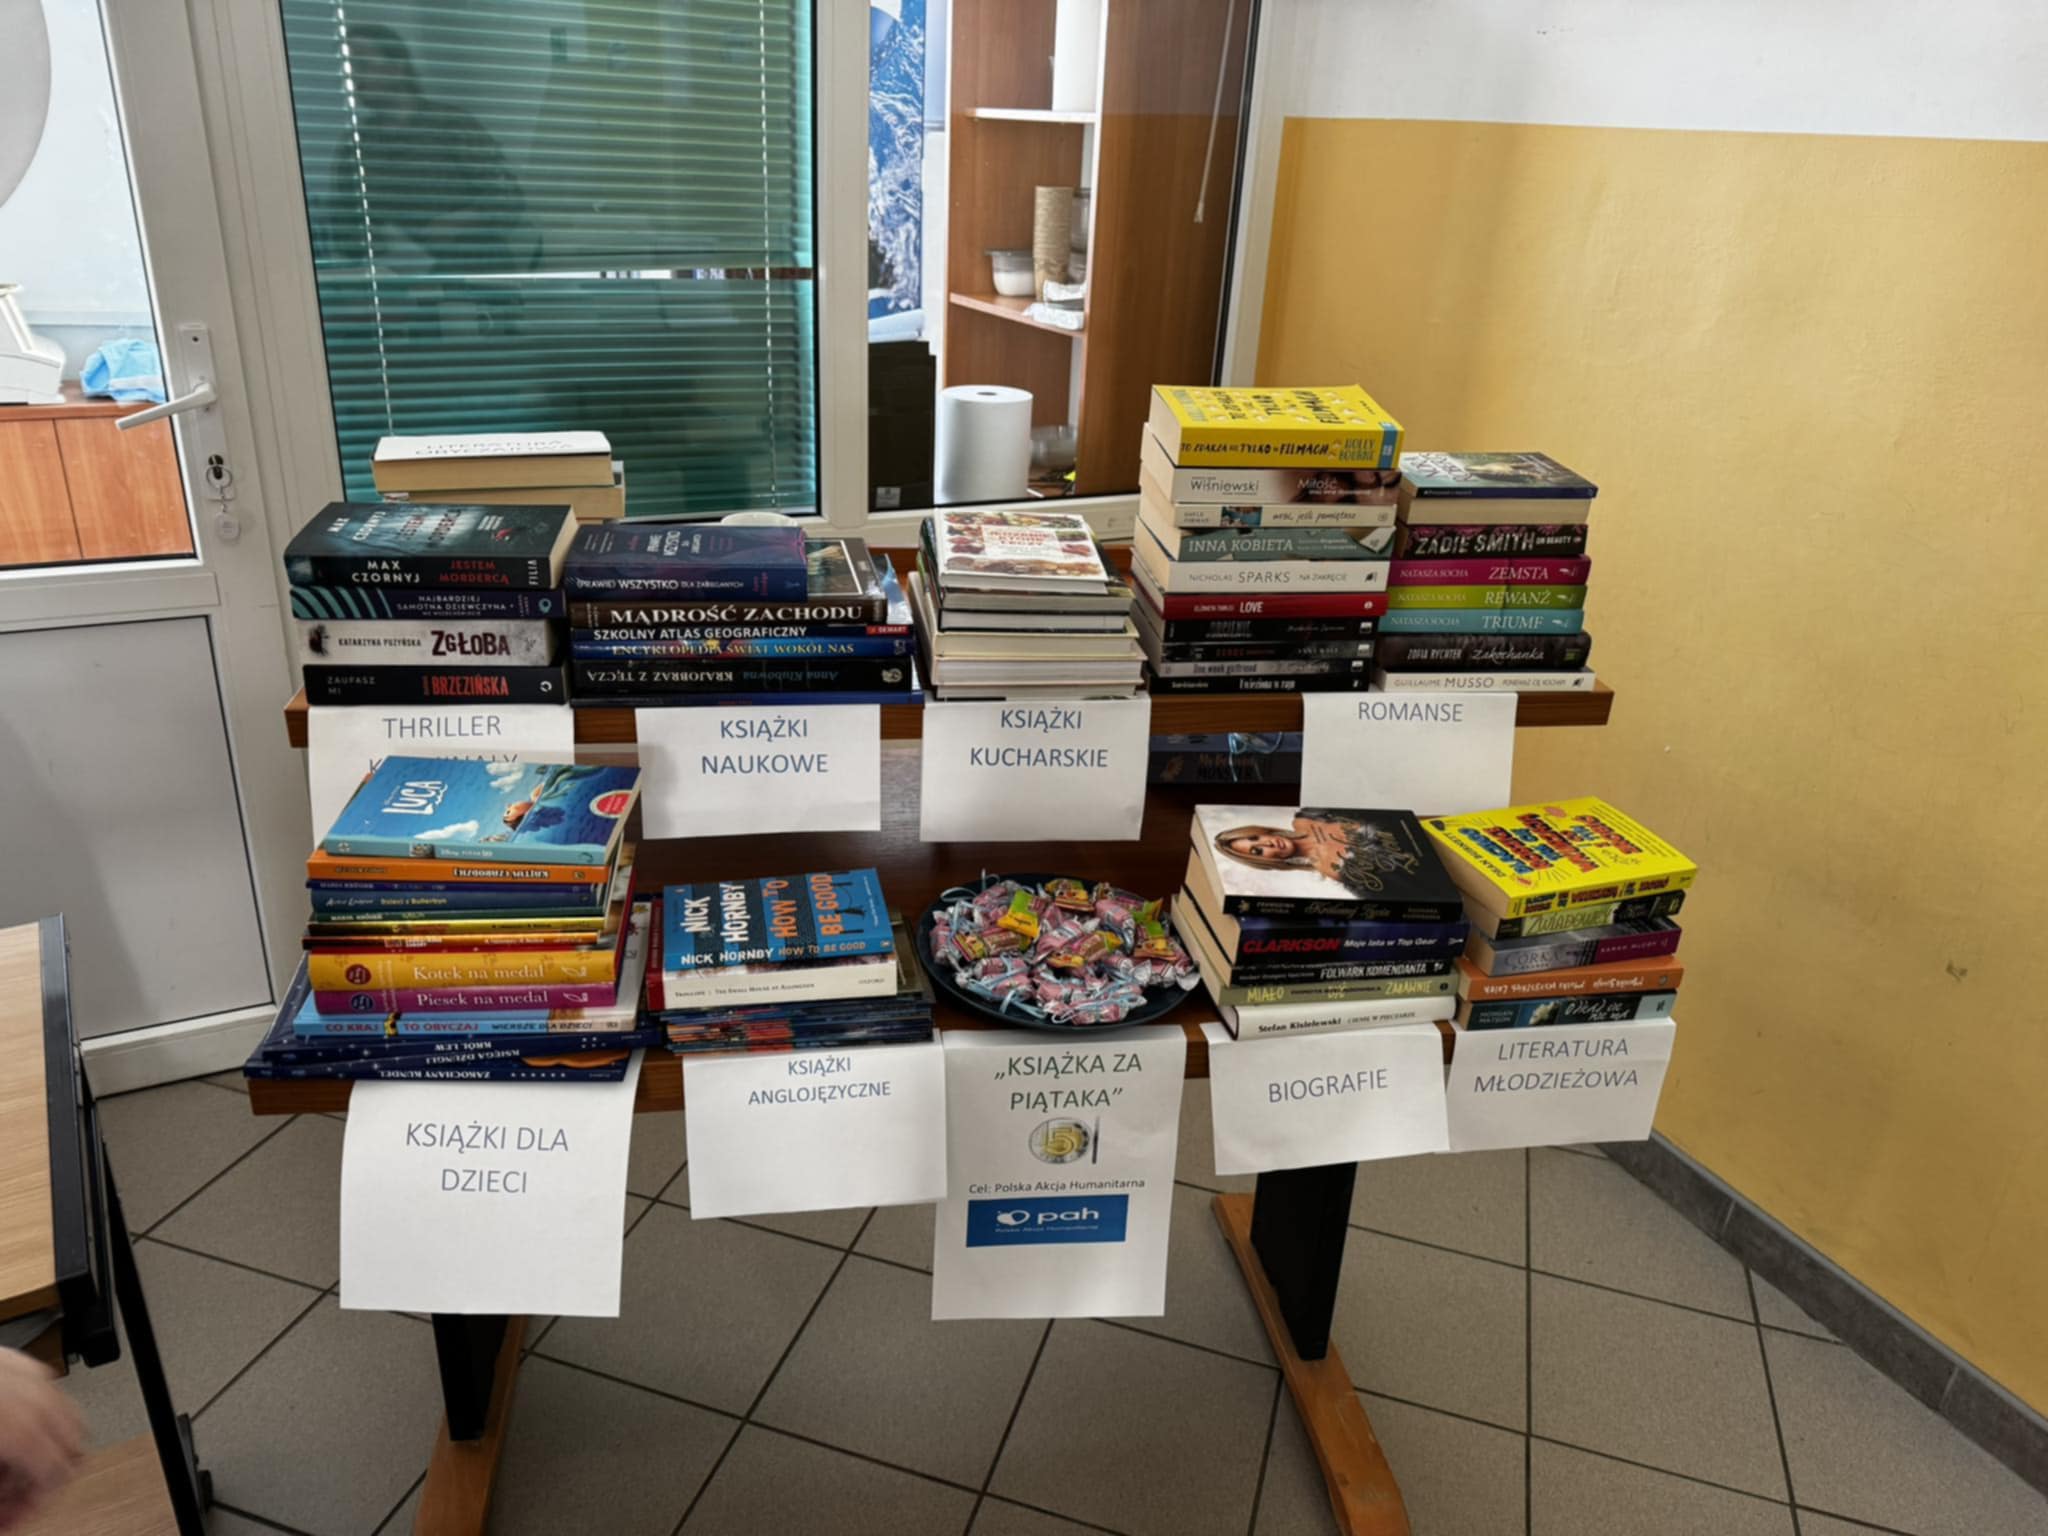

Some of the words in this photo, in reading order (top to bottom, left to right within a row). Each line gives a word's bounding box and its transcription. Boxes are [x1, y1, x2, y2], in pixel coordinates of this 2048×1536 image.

[1190, 478, 1259, 492] Wiśniewski
[1297, 477, 1337, 490] Miłość
[1188, 539, 1227, 553] INNA
[1232, 538, 1294, 552] KOBIETA
[1415, 536, 1469, 555] ZADIE
[1474, 532, 1536, 553] SMITH
[367, 560, 401, 570] MAX
[450, 560, 496, 570] JESTEM
[1488, 566, 1549, 581] ZEMSTA
[351, 572, 421, 584] CZORNYJ
[439, 572, 509, 585] MORDERCĄ
[617, 578, 680, 590] WSZYSTKO
[1238, 571, 1291, 584] SPARKS
[1485, 589, 1552, 605] REWANŻ
[610, 604, 737, 626] MĄDROŚĆ
[744, 606, 862, 622] ZACHODU
[1239, 601, 1264, 614] LOVE
[1482, 615, 1545, 630] TRIUMF
[593, 628, 656, 641] SZKOLNY
[660, 627, 701, 639] ATLAS
[704, 626, 807, 640] GEOGRAFICZNY
[430, 629, 511, 657] ZGŁOBA
[827, 643, 855, 654] NAS
[327, 676, 376, 685] ZAUFASZ
[431, 674, 510, 696] BRZEZIŃSKA
[653, 671, 734, 682] KRAJOBRAZ
[1444, 677, 1495, 689] MUSSO
[1000, 706, 1083, 733] KSIĄŻKI
[1357, 701, 1464, 722] ROMANSE
[382, 715, 501, 738] THRILLER
[720, 715, 808, 742] KSIĄŻKI
[701, 753, 829, 774] NAUKOWE
[970, 747, 1109, 768] KUCHARSKIE
[381, 779, 444, 816] LUCA
[763, 879, 790, 897] TO
[810, 873, 840, 912] GOOD
[680, 895, 711, 934] NICK
[719, 882, 750, 943] HORNBY
[769, 898, 798, 938] HOW
[818, 912, 843, 937] BE
[681, 952, 714, 966] NICK
[719, 947, 775, 963] HORNBY
[778, 945, 804, 957] HOW
[807, 944, 820, 955] TO
[823, 943, 837, 953] BE
[839, 941, 866, 952] GOOD
[1242, 937, 1341, 955] CLARKSON
[1397, 938, 1414, 949] Top
[1415, 936, 1438, 946] Gear
[413, 966, 463, 981] Kotek
[468, 970, 488, 980] na
[494, 963, 545, 979] medal
[1320, 966, 1365, 980] FOLWARK
[1367, 961, 1427, 977] KOMENDANTA
[417, 992, 468, 1008] Piesek
[474, 995, 494, 1005] na
[501, 989, 549, 1005] medal
[1247, 986, 1285, 1002] MIAŁO
[325, 1022, 344, 1032] CO
[347, 1022, 380, 1032] KRAJ
[403, 1022, 420, 1032] TO
[423, 1022, 479, 1032] OBYCZAJ
[491, 1023, 538, 1032] WIERSZE
[1258, 1022, 1287, 1033] Stefan
[1289, 1017, 1341, 1031] Kisielewski
[434, 1042, 459, 1052] LEW
[463, 1041, 492, 1051] KRÓL
[476, 1049, 521, 1060] KSIĘGA
[1497, 1038, 1630, 1062] LITERATURA
[425, 1053, 475, 1065] DŻUNGLI
[788, 1055, 851, 1077] KSIĄŻKI
[994, 1051, 1105, 1080] „KSIĄŻKA
[1112, 1053, 1143, 1073] ZA
[378, 1070, 422, 1079] KUNDEL
[424, 1071, 491, 1079] ZAKOCHANY
[1473, 1069, 1639, 1094] MŁODZIEŻOWA
[748, 1081, 891, 1105] ANGLOJĘZYCZNE
[1267, 1067, 1390, 1103] BIOGRAFIE
[1010, 1088, 1123, 1113] PIĄTAKA”
[405, 1120, 507, 1154] KSIĄŻKI
[516, 1127, 569, 1152] DLA
[1049, 1126, 1076, 1157] 5
[441, 1168, 528, 1193] DZIECI
[969, 1183, 992, 1194] Cel:
[995, 1181, 1032, 1193] Polska
[1034, 1180, 1067, 1193] Akcja
[1069, 1178, 1146, 1190] Humanitarna
[1036, 1207, 1100, 1225] pah
